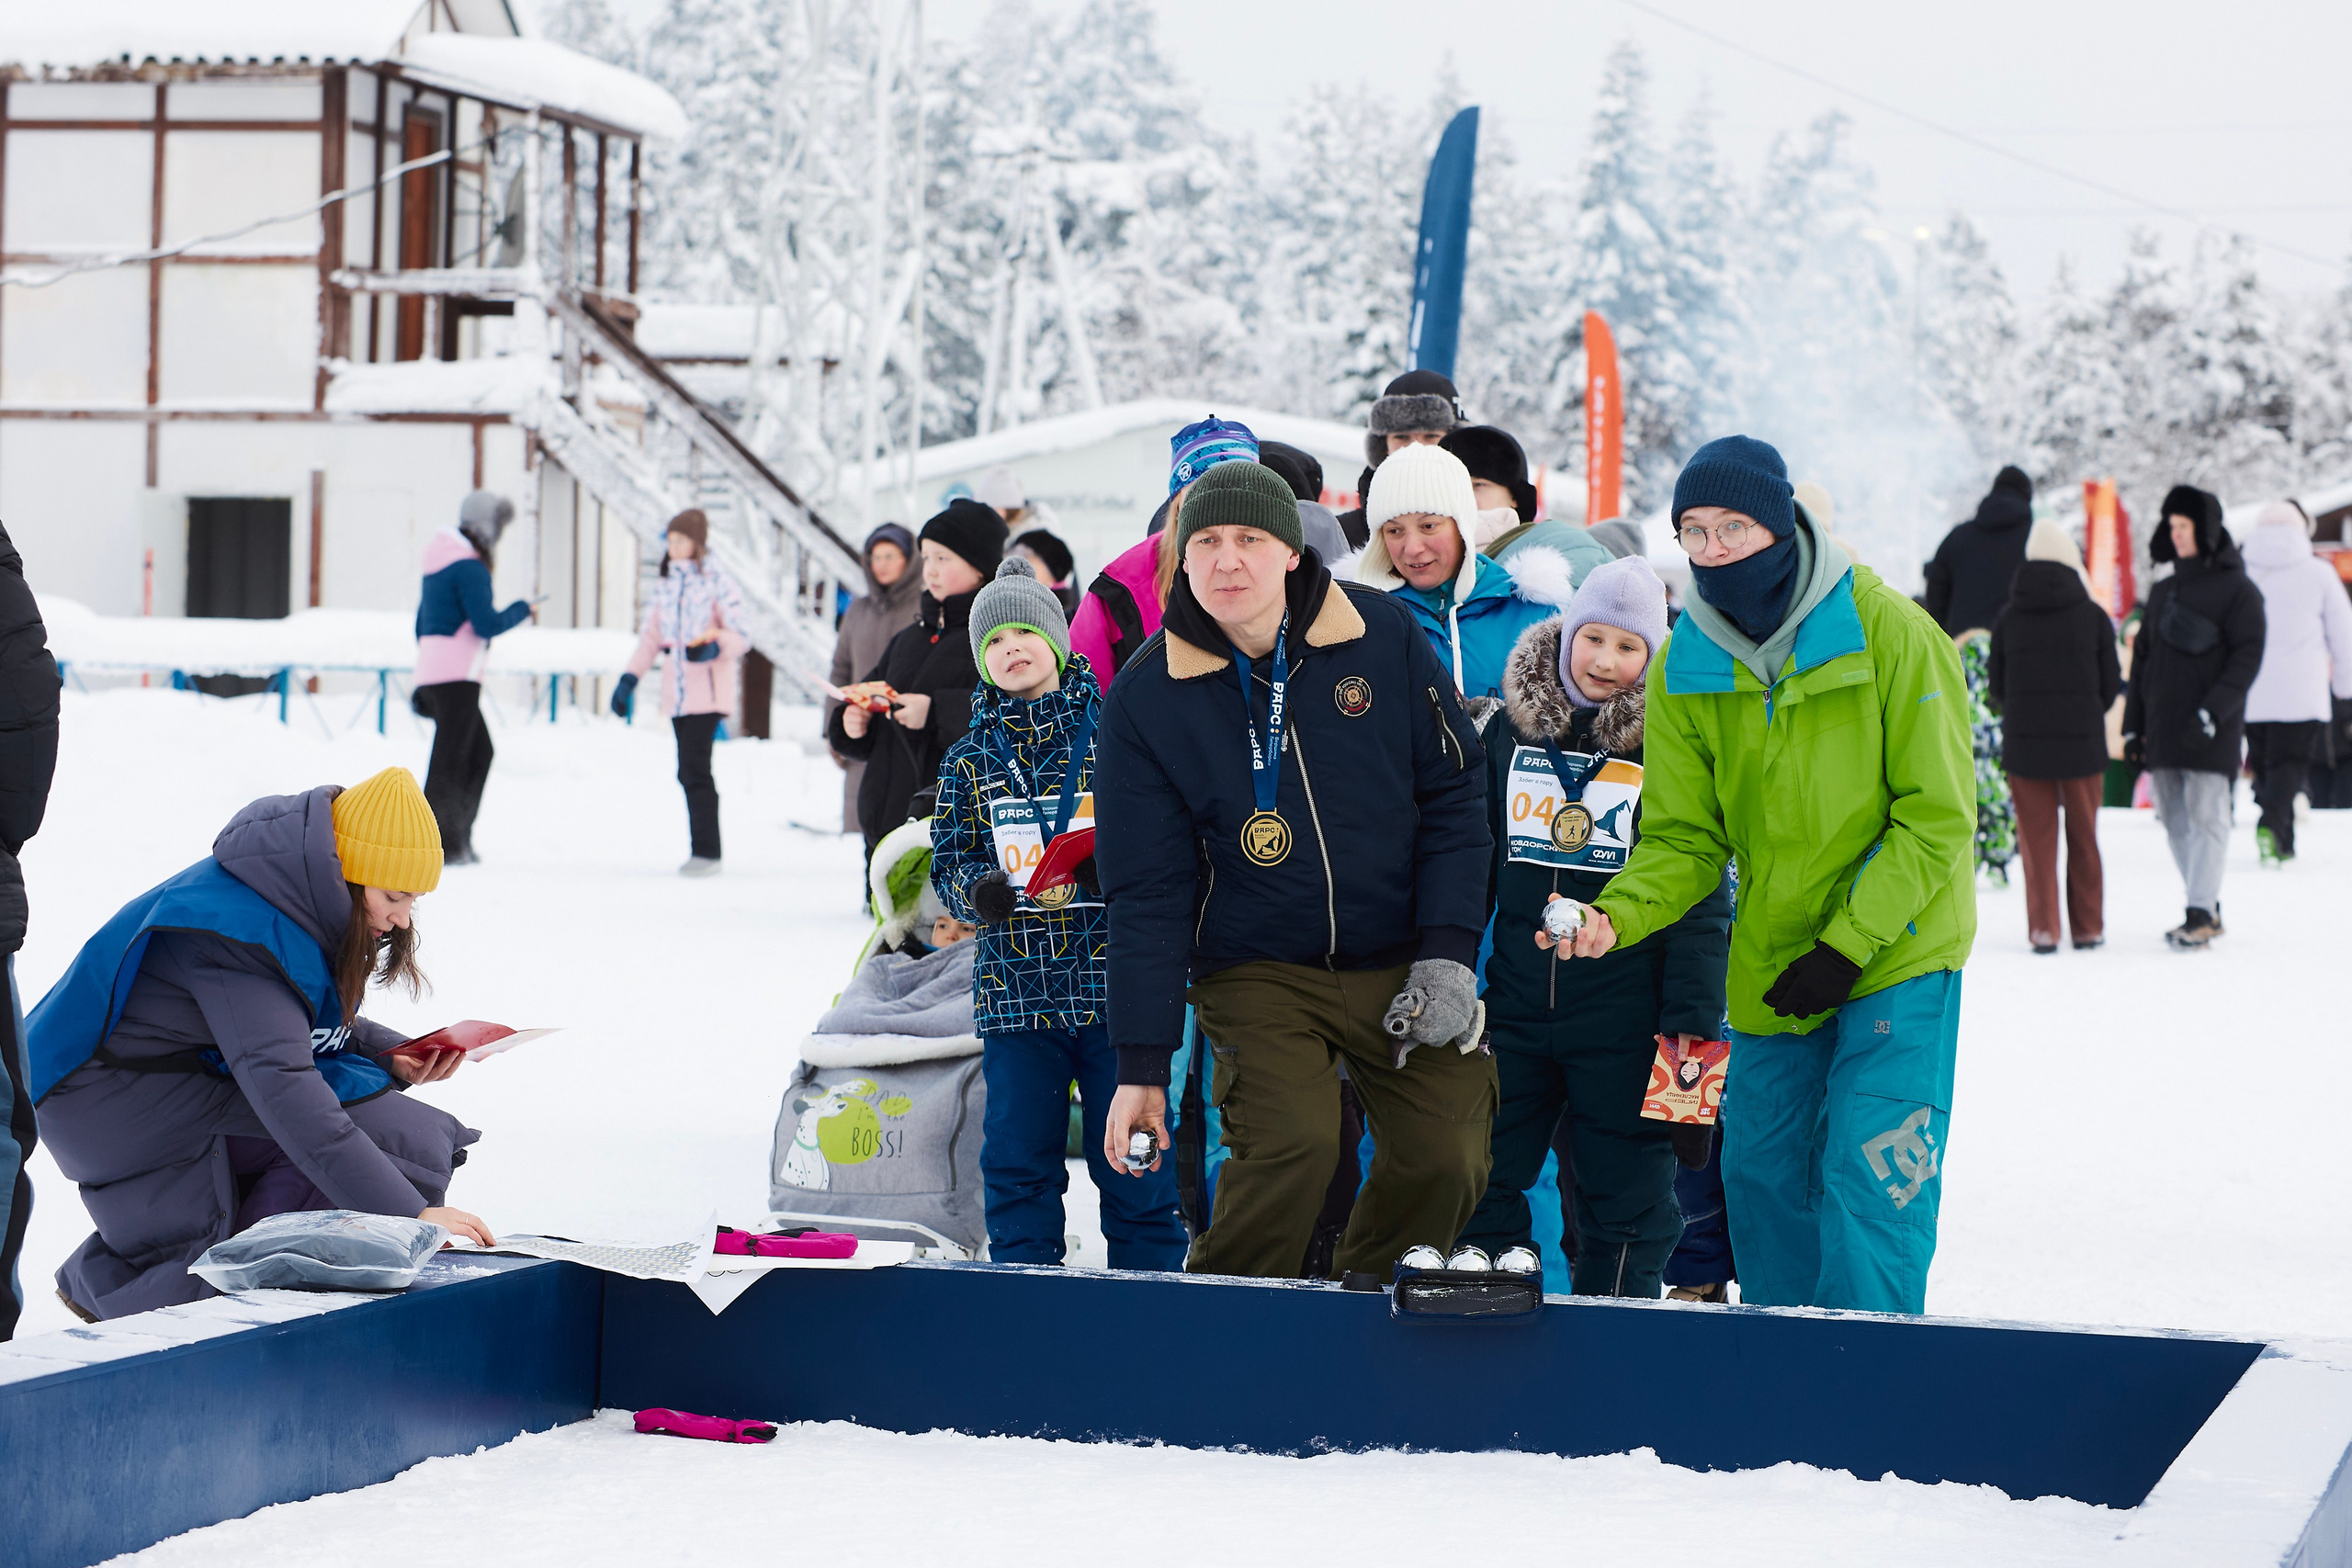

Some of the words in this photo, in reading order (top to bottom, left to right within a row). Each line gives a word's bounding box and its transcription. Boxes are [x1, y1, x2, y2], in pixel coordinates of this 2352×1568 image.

[1270, 681, 1284, 726] ВАРС
[1249, 728, 1264, 770] ВАРС
[1007, 758, 1028, 794] ВАРС
[1540, 779, 1554, 787] гору
[998, 808, 1035, 820] ВАРС
[1512, 792, 1566, 827] 04
[1666, 1091, 1700, 1100] МАСЛЕНИЦА
[888, 1111, 906, 1122] the
[852, 1127, 903, 1158] BOSS!
